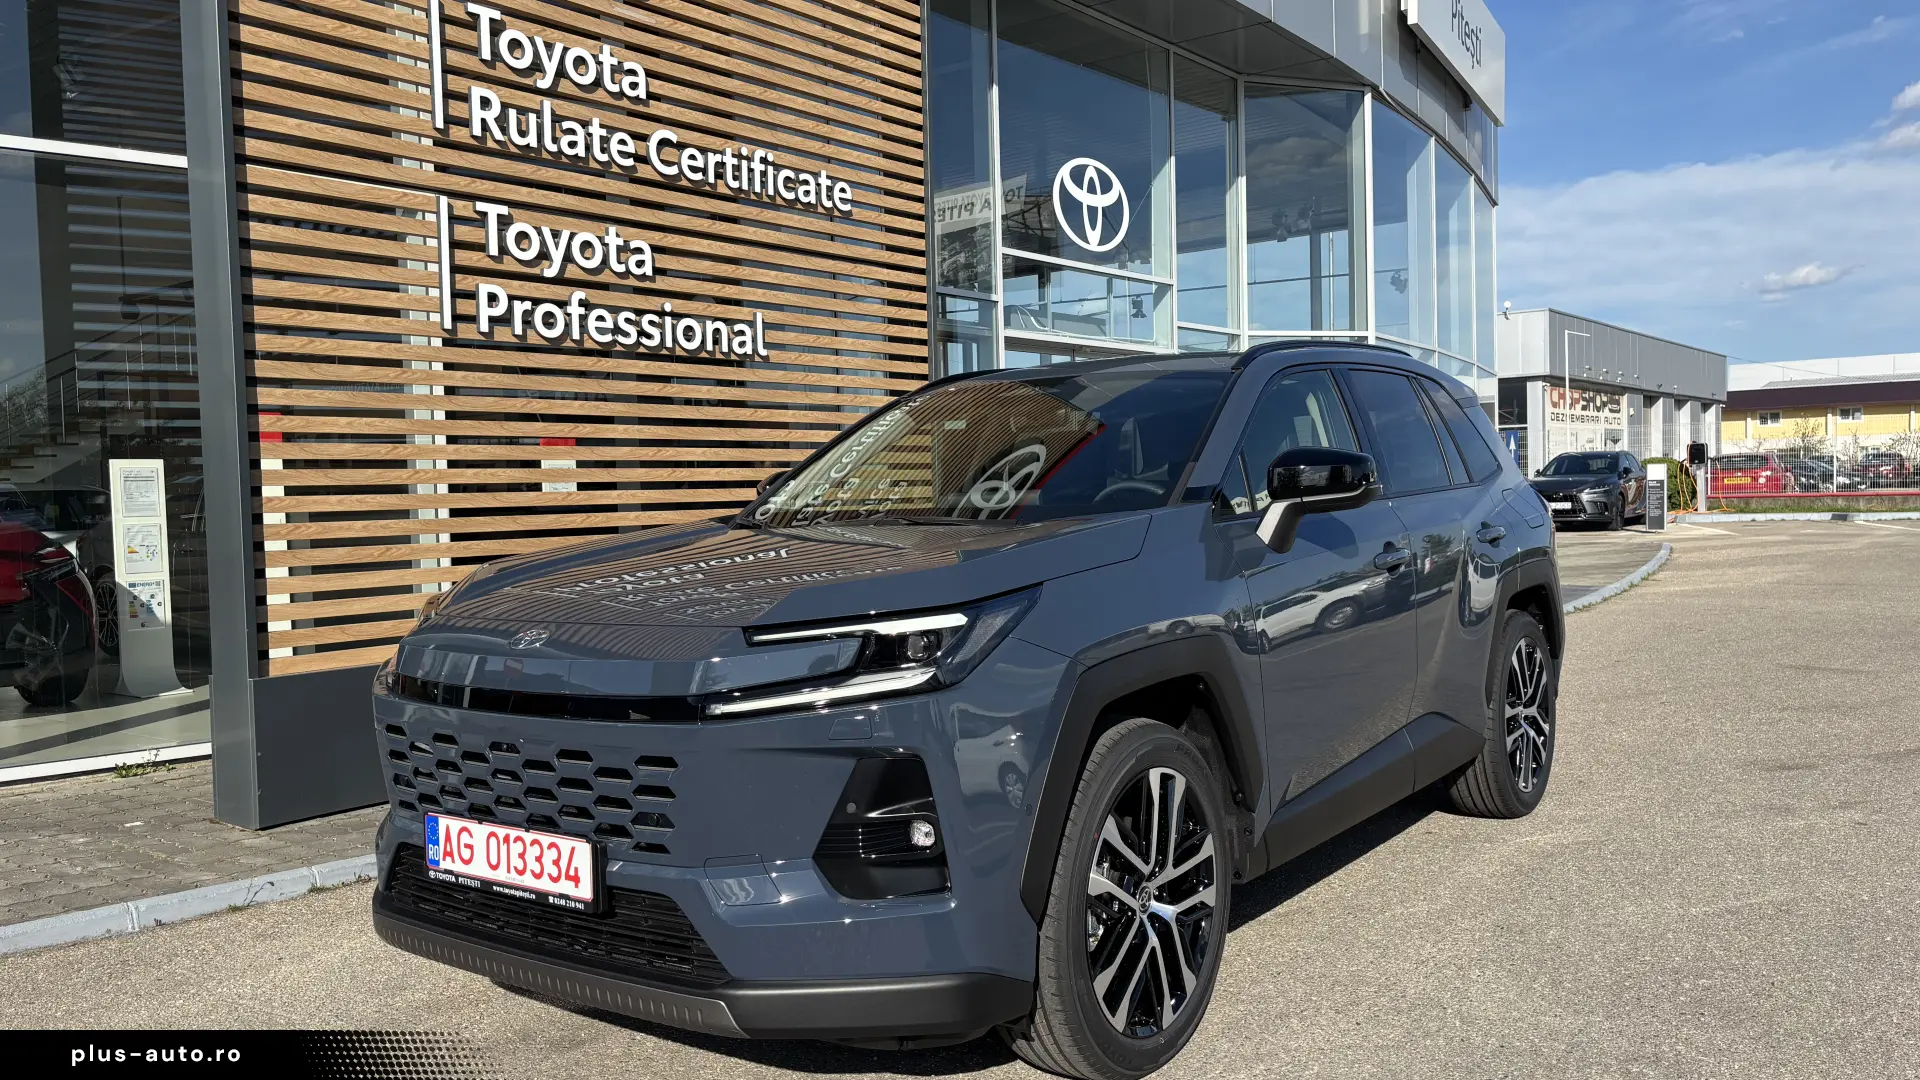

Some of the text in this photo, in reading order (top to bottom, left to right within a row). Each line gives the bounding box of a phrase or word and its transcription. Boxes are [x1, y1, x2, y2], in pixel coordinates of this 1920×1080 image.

[465, 3, 649, 100] Toyota
[469, 85, 853, 212] Rulate Certificate
[474, 201, 654, 277] Toyota
[475, 284, 769, 357] Professional
[1604, 416, 1621, 425] AUTO
[428, 844, 440, 860] RO
[436, 871, 457, 883] TOYOTA
[442, 823, 581, 889] AG 013334
